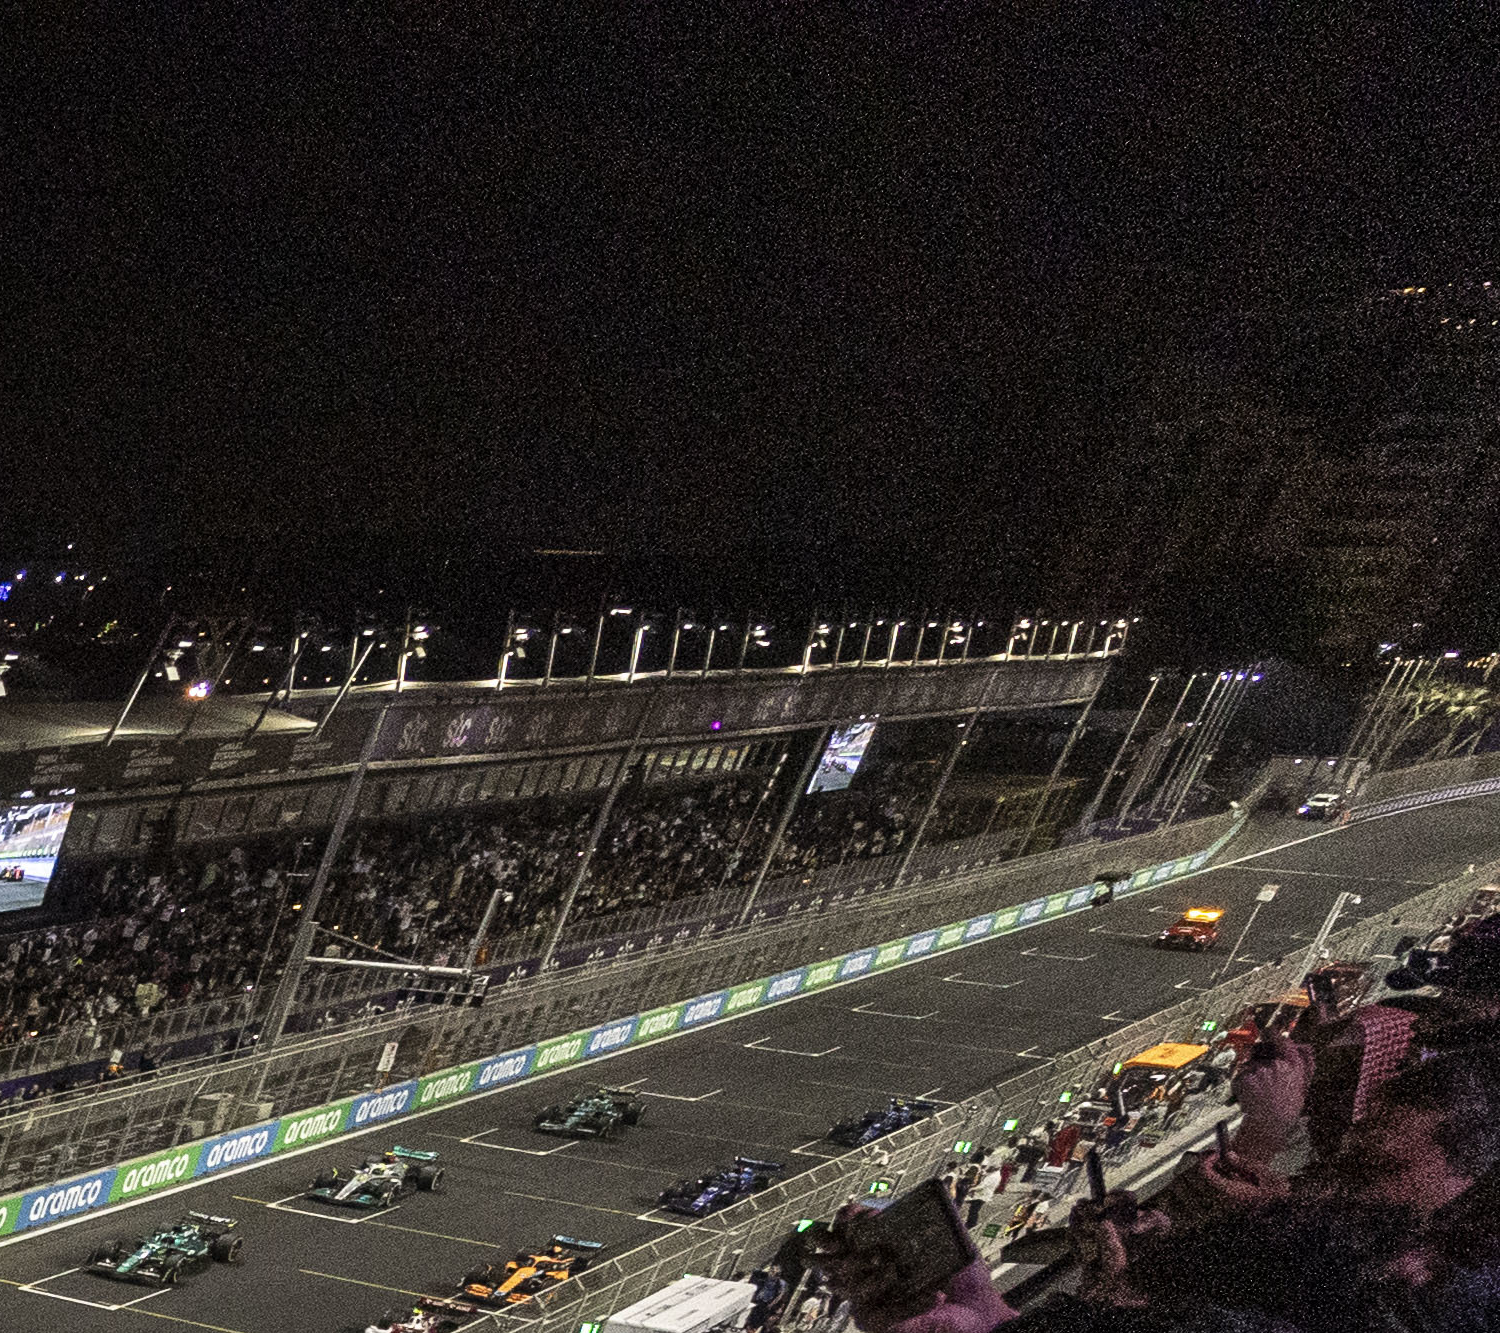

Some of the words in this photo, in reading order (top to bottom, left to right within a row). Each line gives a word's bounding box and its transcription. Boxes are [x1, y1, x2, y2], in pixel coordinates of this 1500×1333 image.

[538, 1038, 581, 1067] aramco
[422, 1071, 471, 1102] aramco
[480, 1055, 526, 1085] aramco
[355, 1090, 408, 1122] aramco
[283, 1109, 341, 1145] aramco
[206, 1130, 269, 1168] aramco
[122, 1153, 190, 1194] aramco
[29, 1178, 102, 1221] aramco
